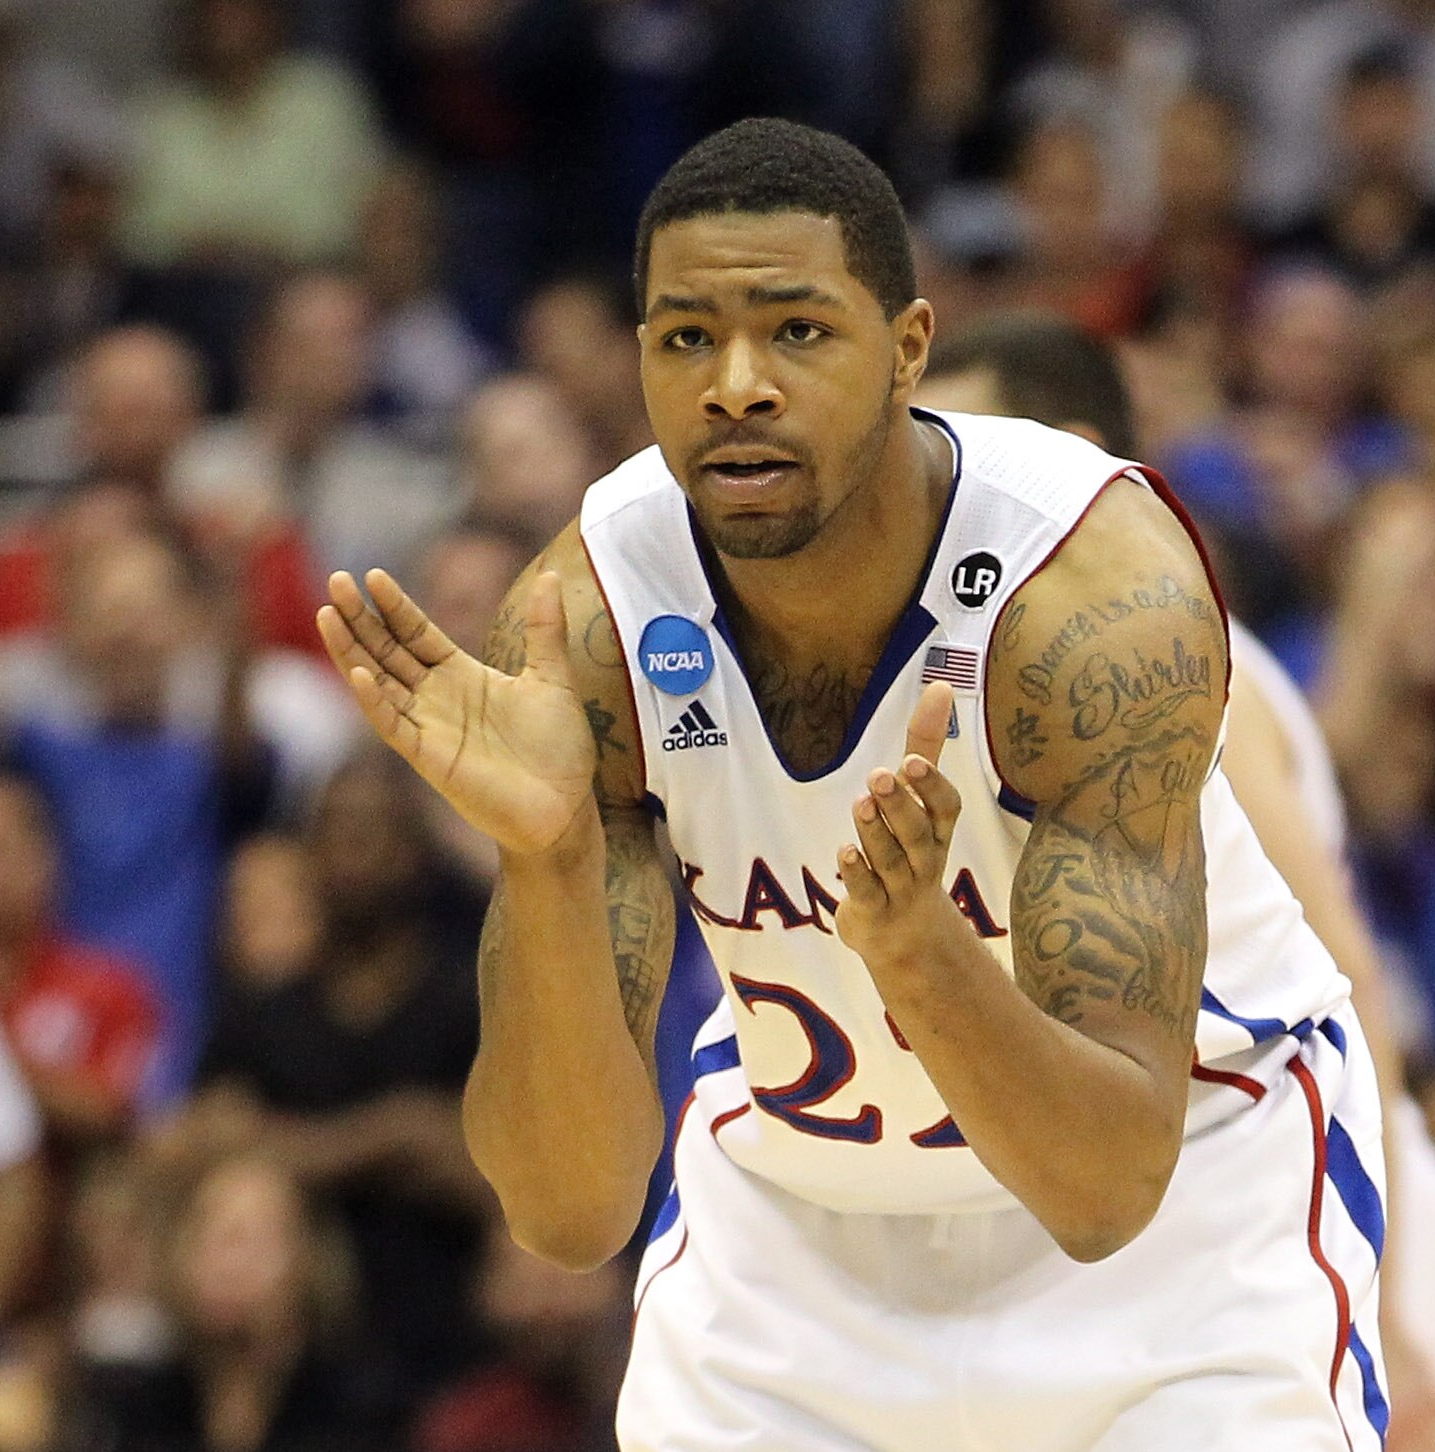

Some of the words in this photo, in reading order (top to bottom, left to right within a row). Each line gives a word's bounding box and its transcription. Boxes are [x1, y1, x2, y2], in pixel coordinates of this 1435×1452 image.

[955, 566, 997, 596] LR
[647, 650, 705, 672] NCAA
[1068, 637, 1212, 741] Shirley
[662, 730, 728, 752] adidas
[729, 971, 969, 1149] 2
